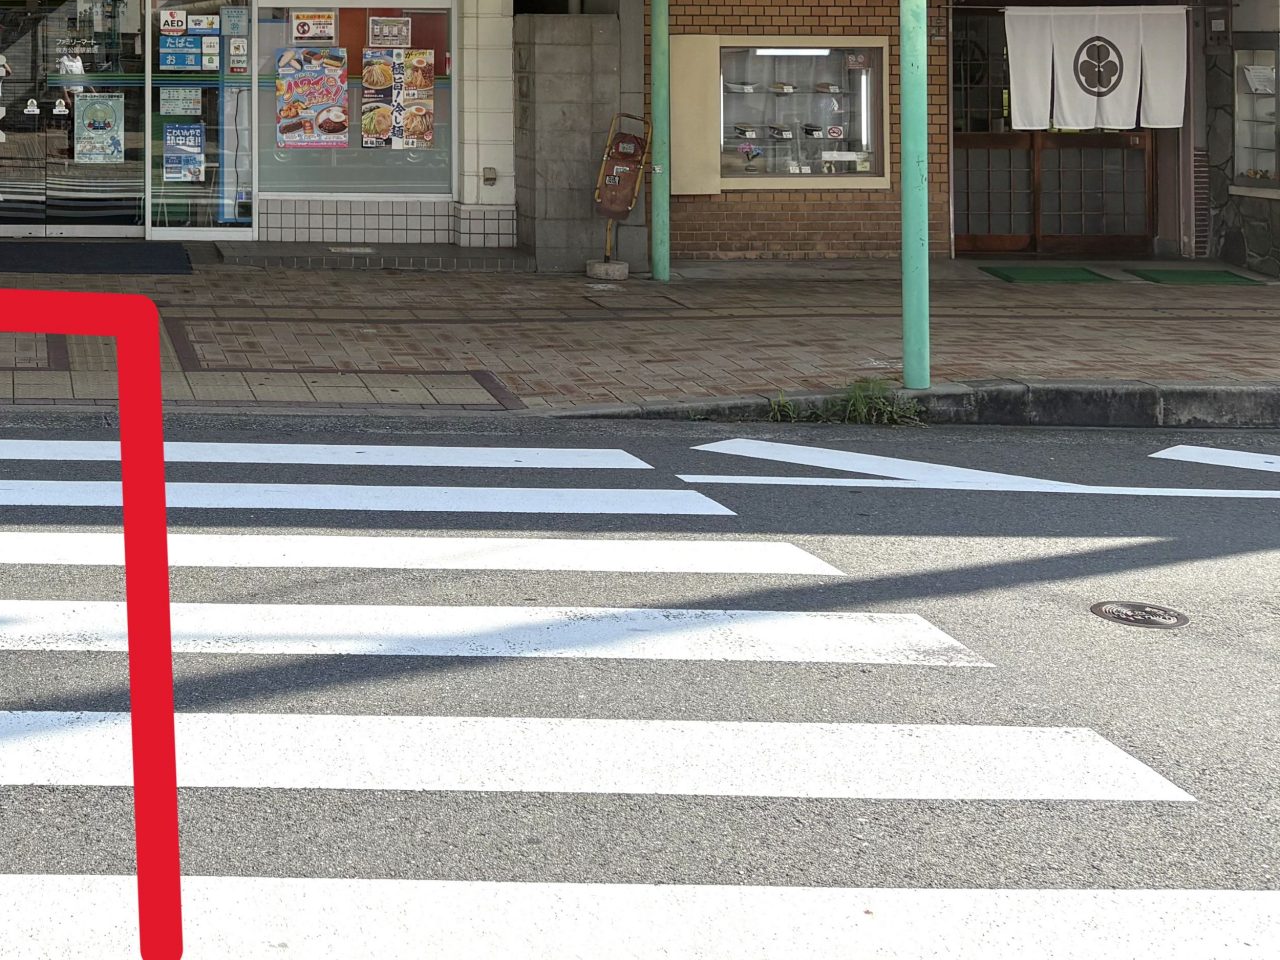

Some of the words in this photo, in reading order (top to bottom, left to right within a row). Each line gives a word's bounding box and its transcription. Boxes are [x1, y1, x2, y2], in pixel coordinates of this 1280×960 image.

[56, 38, 97, 46] ファミリーマート
[166, 37, 194, 48] たばこ
